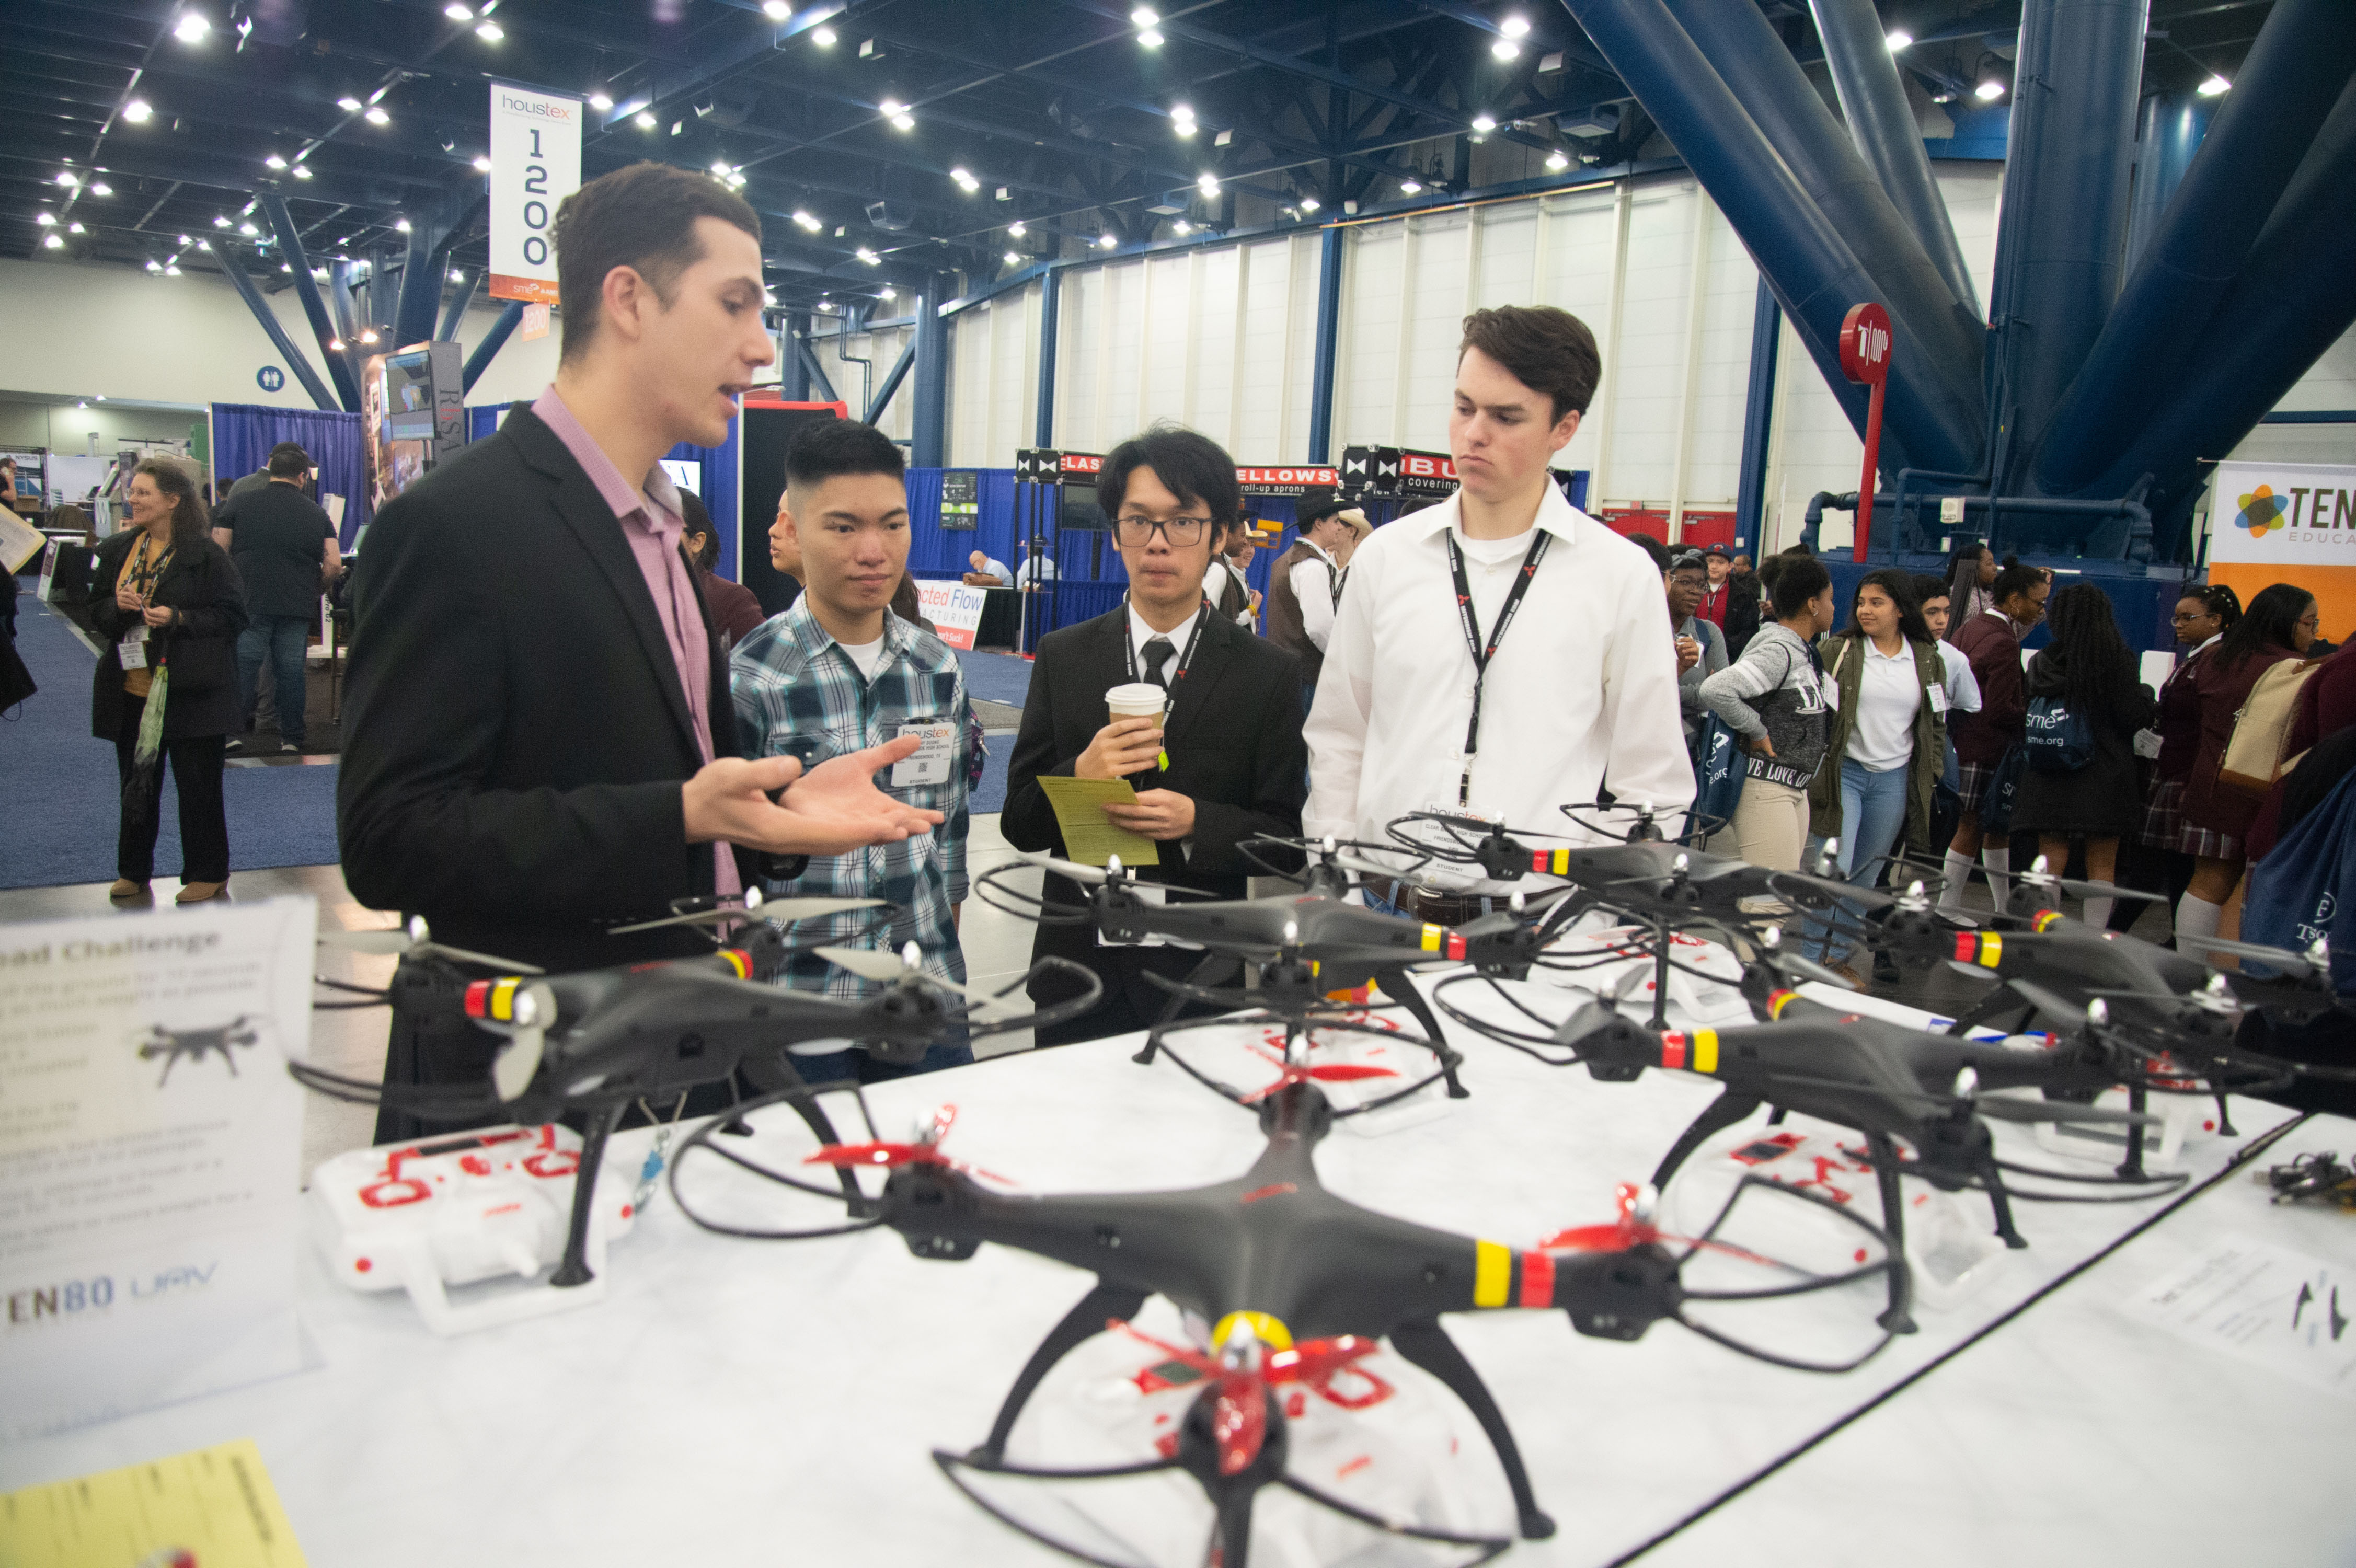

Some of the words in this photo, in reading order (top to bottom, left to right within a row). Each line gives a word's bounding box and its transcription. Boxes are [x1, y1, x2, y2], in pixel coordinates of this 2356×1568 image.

[503, 94, 570, 120] houstex
[524, 129, 548, 266] 1200
[524, 308, 546, 333] 1200
[1236, 469, 1331, 482] ELLOWS
[1408, 477, 1458, 492] covering
[1241, 484, 1270, 493] roll-up
[1274, 485, 1305, 493] aprons
[2290, 488, 2356, 529] TEN
[2289, 532, 2356, 544] EDUCA
[919, 585, 950, 606] cted
[951, 589, 983, 610] Flow
[922, 609, 977, 625] ACTURING
[1460, 605, 1473, 639] MITSUBISHI
[1494, 612, 1512, 645] MITSUBISHI
[2026, 713, 2056, 729] sme
[2028, 736, 2064, 747] sme.org
[1748, 757, 1764, 776] VE
[1766, 763, 1797, 785] LOVE
[1795, 773, 1812, 788] LO
[1436, 863, 1463, 872] STUDENT
[61, 933, 220, 961] Challenge
[0, 1275, 114, 1324] EN80
